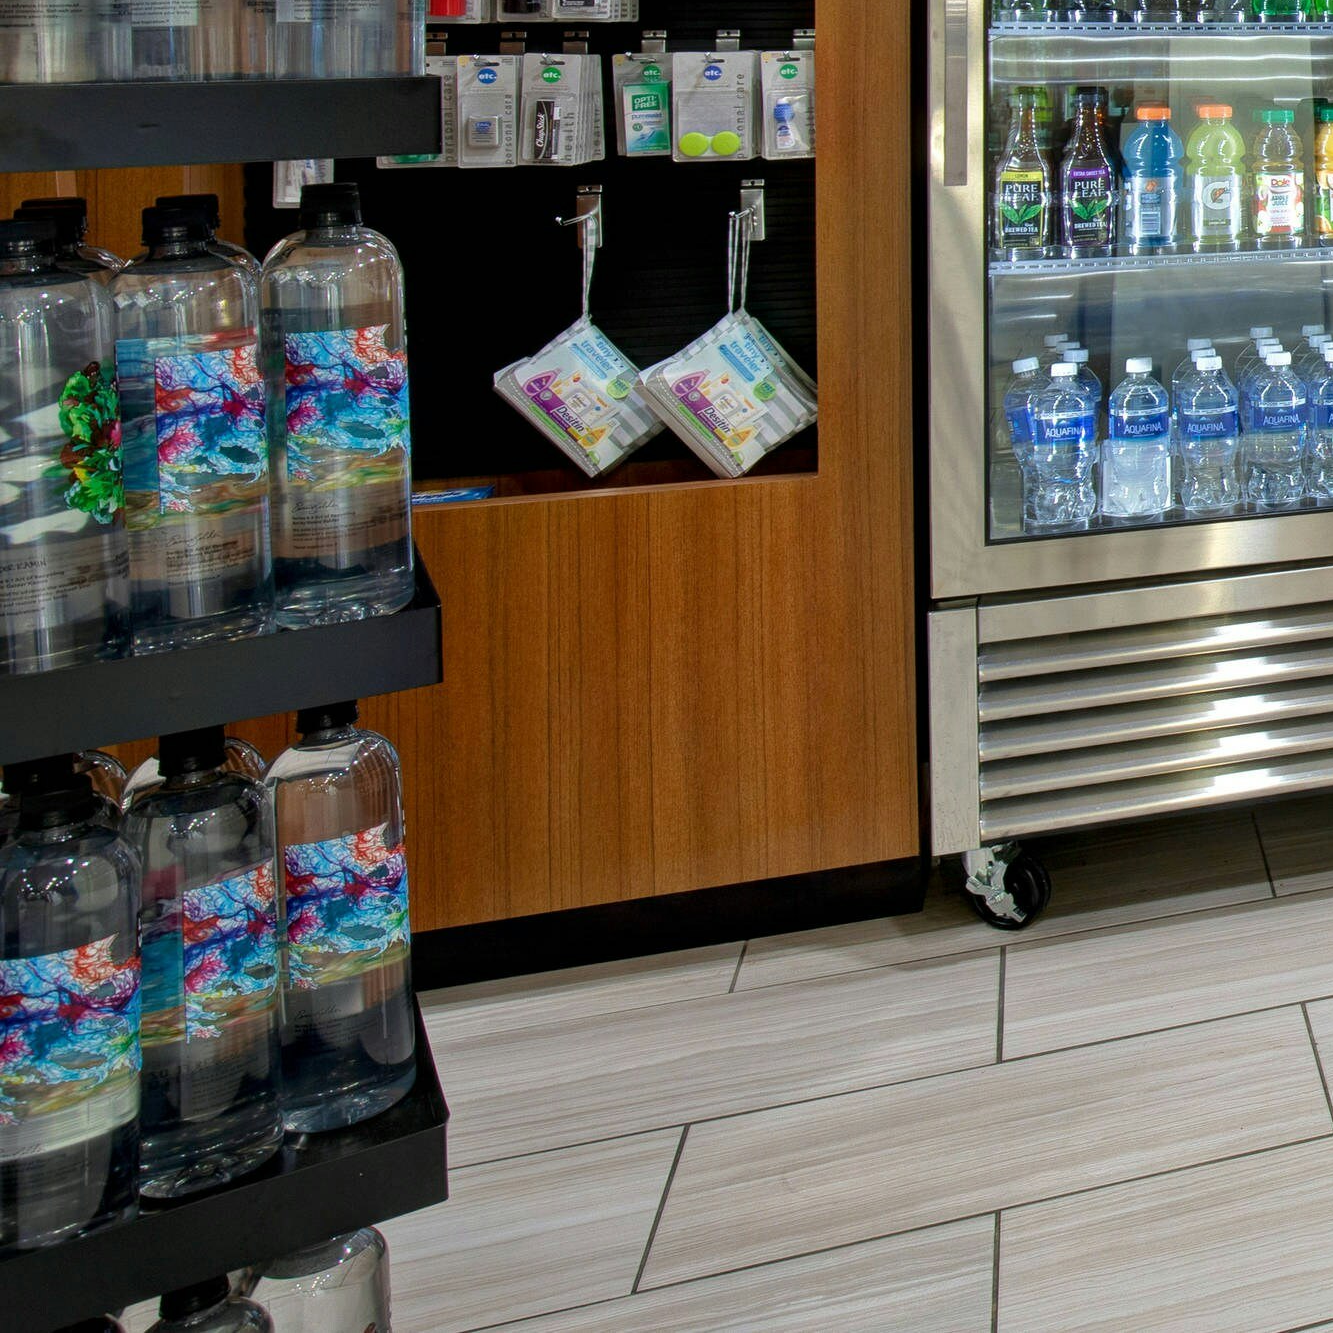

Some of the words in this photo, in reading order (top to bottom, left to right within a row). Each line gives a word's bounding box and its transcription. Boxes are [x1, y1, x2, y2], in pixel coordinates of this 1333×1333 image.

[564, 111, 575, 162] health
[1005, 184, 1038, 194] PURE
[1074, 181, 1105, 191] PURE
[557, 404, 586, 433] Desitin
[703, 405, 732, 434] Desitin
[1263, 414, 1300, 427] AQUAFINA
[1124, 422, 1163, 435] AQUAFINA
[1187, 422, 1226, 433] AQUAFINA
